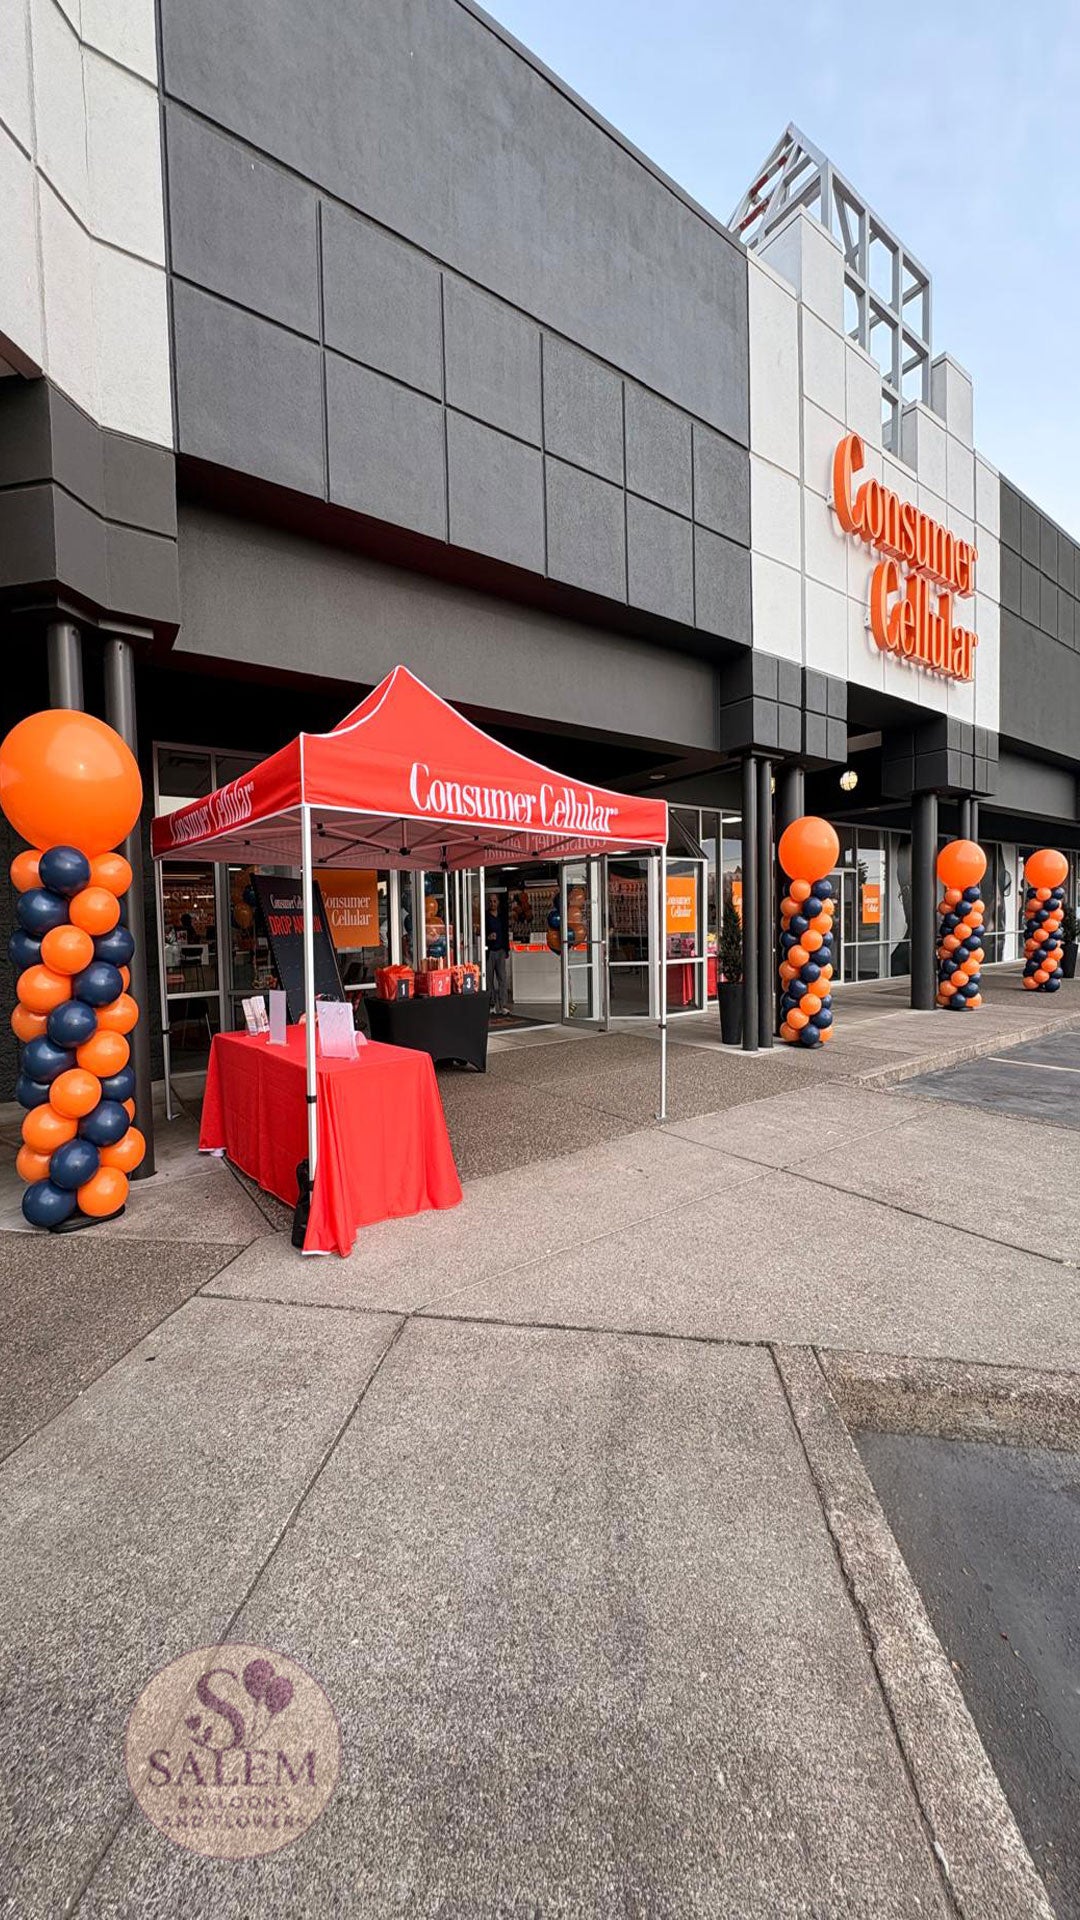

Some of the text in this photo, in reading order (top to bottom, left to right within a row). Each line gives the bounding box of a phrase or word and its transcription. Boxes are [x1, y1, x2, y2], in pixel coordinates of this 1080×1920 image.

[831, 432, 979, 599] Consumer
[869, 558, 979, 684] Cellular
[409, 762, 536, 824] Consumer
[169, 778, 254, 846] Consumer Cellular
[269, 915, 292, 936] DROP
[332, 908, 372, 927] Cellular
[401, 983, 406, 996] 1
[438, 980, 443, 992] 2
[466, 976, 471, 989] 3
